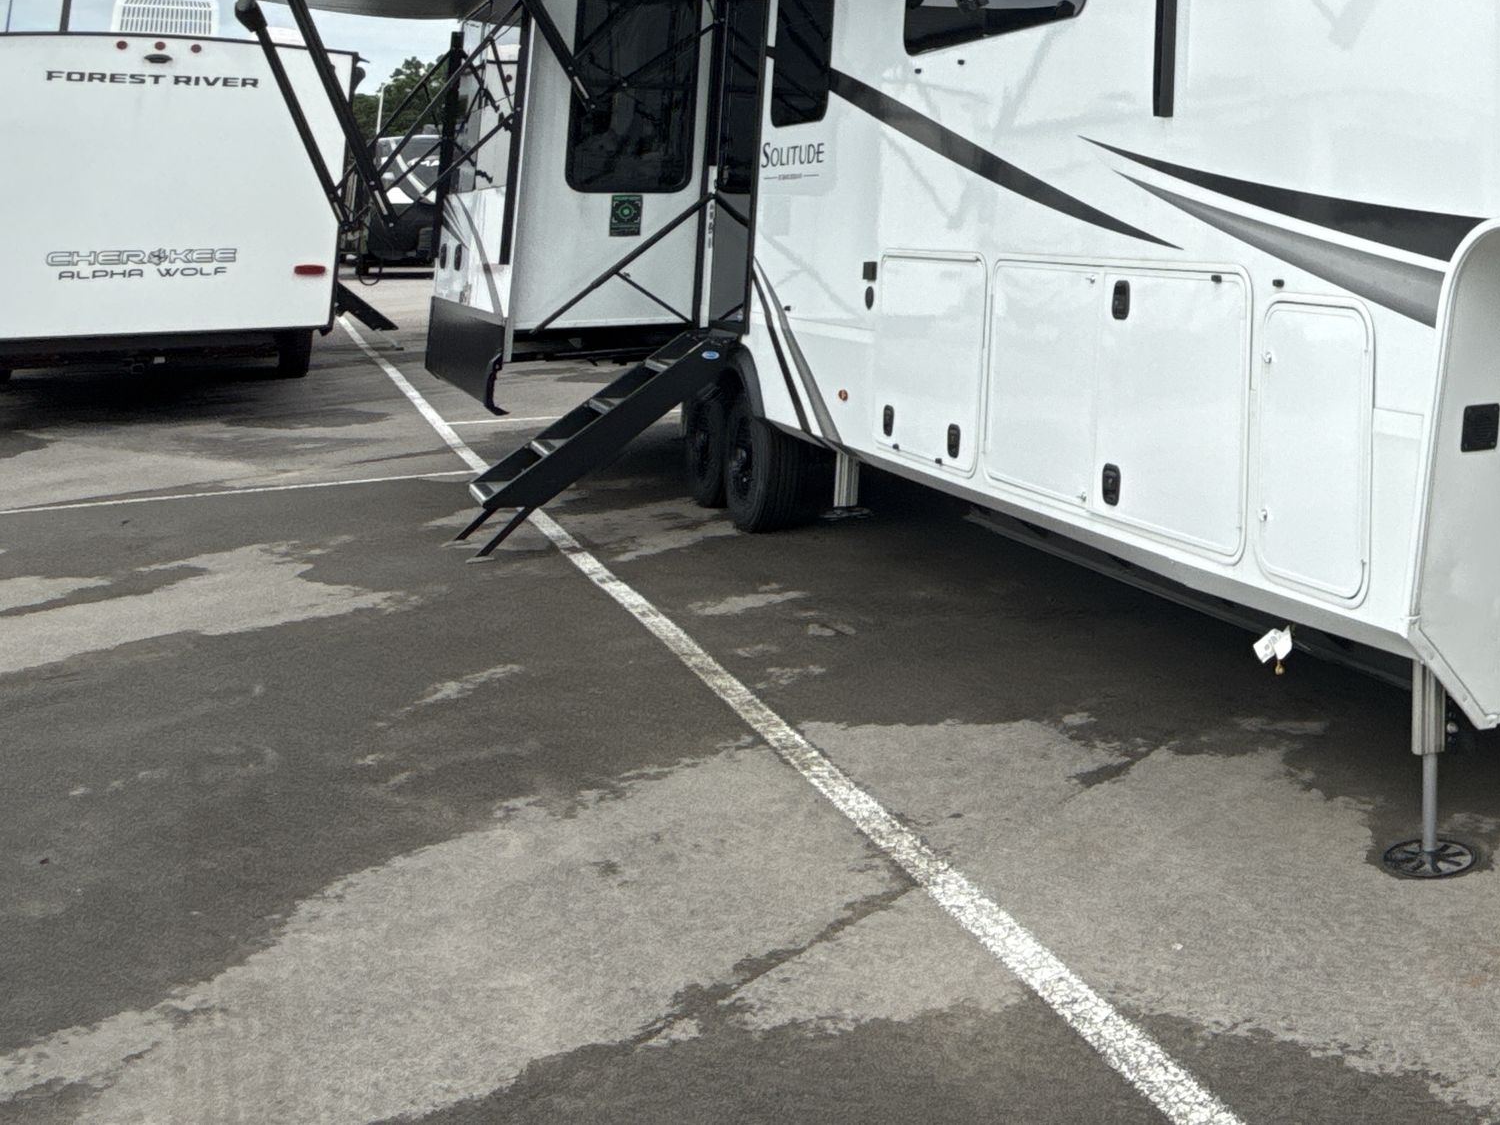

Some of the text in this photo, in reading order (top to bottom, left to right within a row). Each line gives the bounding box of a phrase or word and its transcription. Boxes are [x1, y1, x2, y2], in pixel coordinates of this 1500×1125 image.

[46, 70, 259, 88] FOREST RIVER
[761, 142, 824, 168] SOLITUDE
[58, 267, 227, 280] ALPHA WOLF
